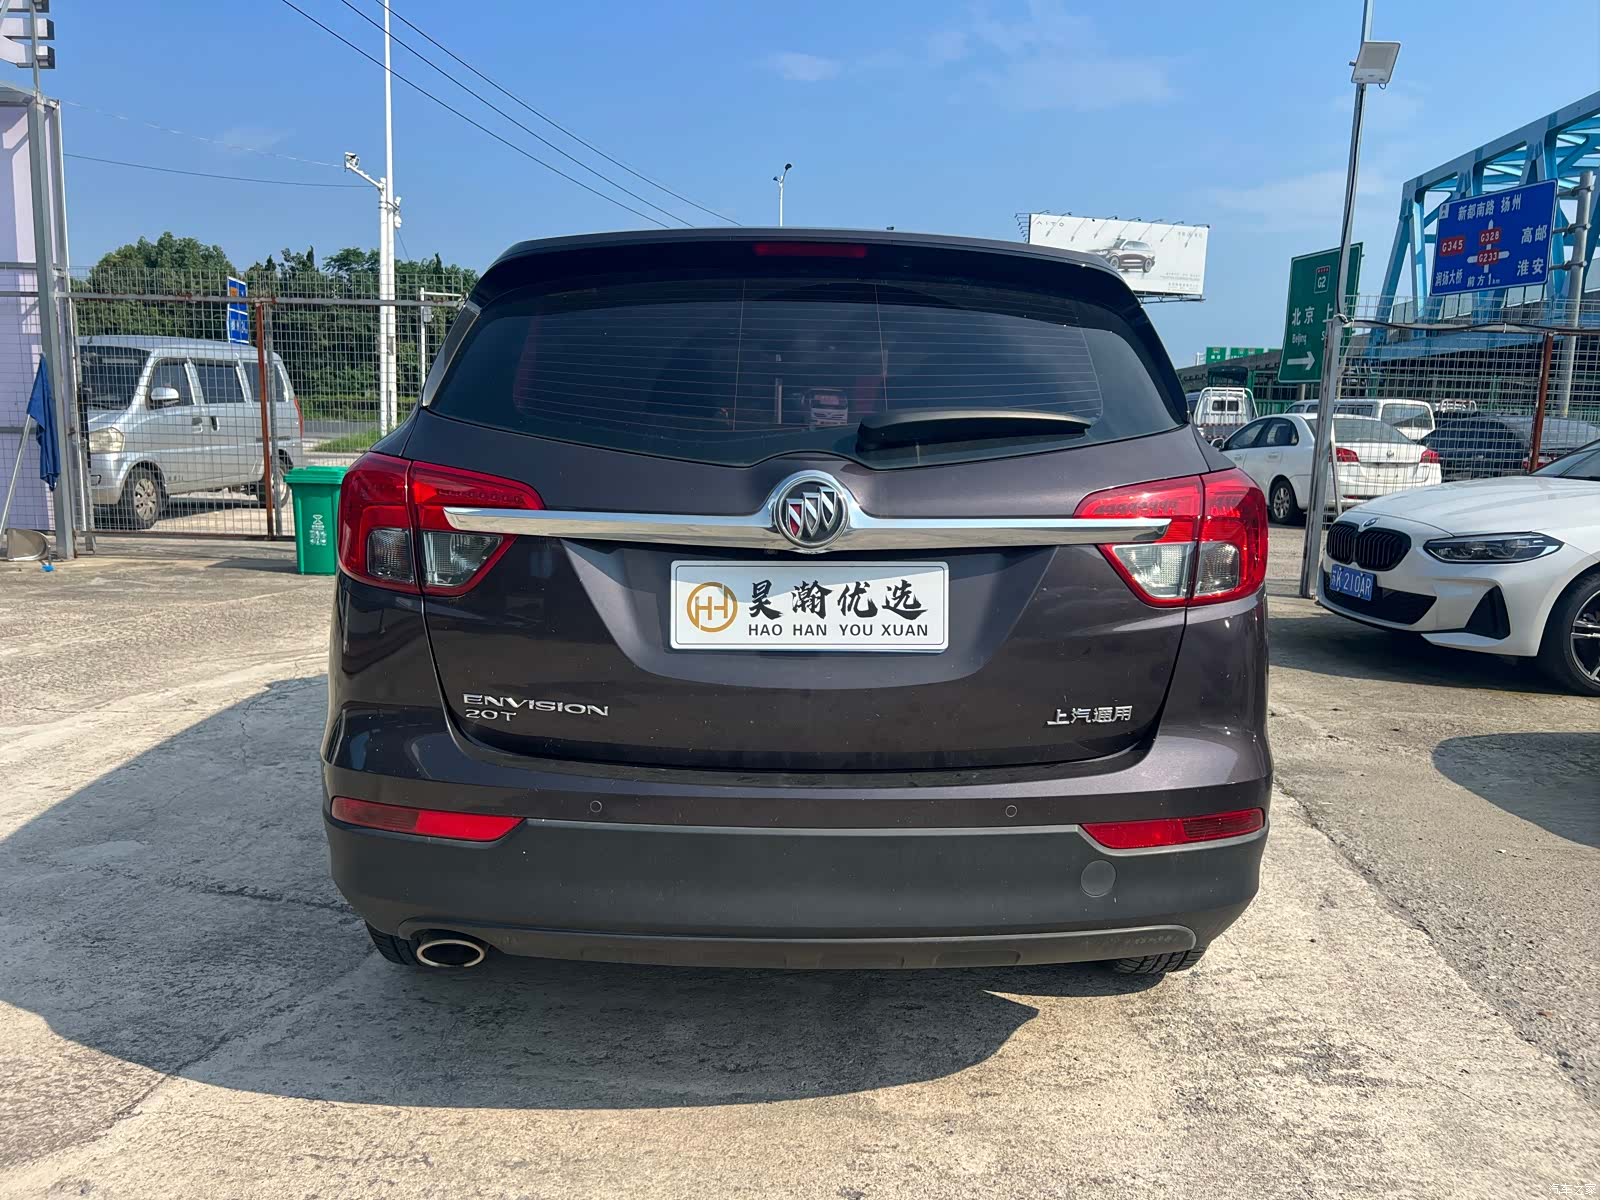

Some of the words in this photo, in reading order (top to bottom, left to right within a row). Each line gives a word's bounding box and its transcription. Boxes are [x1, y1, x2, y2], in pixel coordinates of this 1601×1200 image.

[1457, 200, 1495, 222] 新都南路
[1501, 194, 1522, 213] 扬州
[1480, 230, 1500, 243] G328
[1521, 225, 1547, 244] 高邮
[1442, 240, 1463, 253] G345
[1478, 252, 1498, 263] G233
[1517, 258, 1544, 276] 淮安
[1317, 275, 1326, 289] G2
[1292, 306, 1315, 326] 北京
[1292, 334, 1307, 346] Beijing
[749, 579, 928, 620] 昊瀚优选
[748, 624, 783, 636] HAO
[793, 624, 827, 636] HAN
[839, 624, 873, 636] YOU
[881, 624, 928, 636] XUAN
[463, 693, 609, 716] ENVISION
[465, 709, 517, 722] 20T
[1047, 705, 1133, 725] 上汽通用
